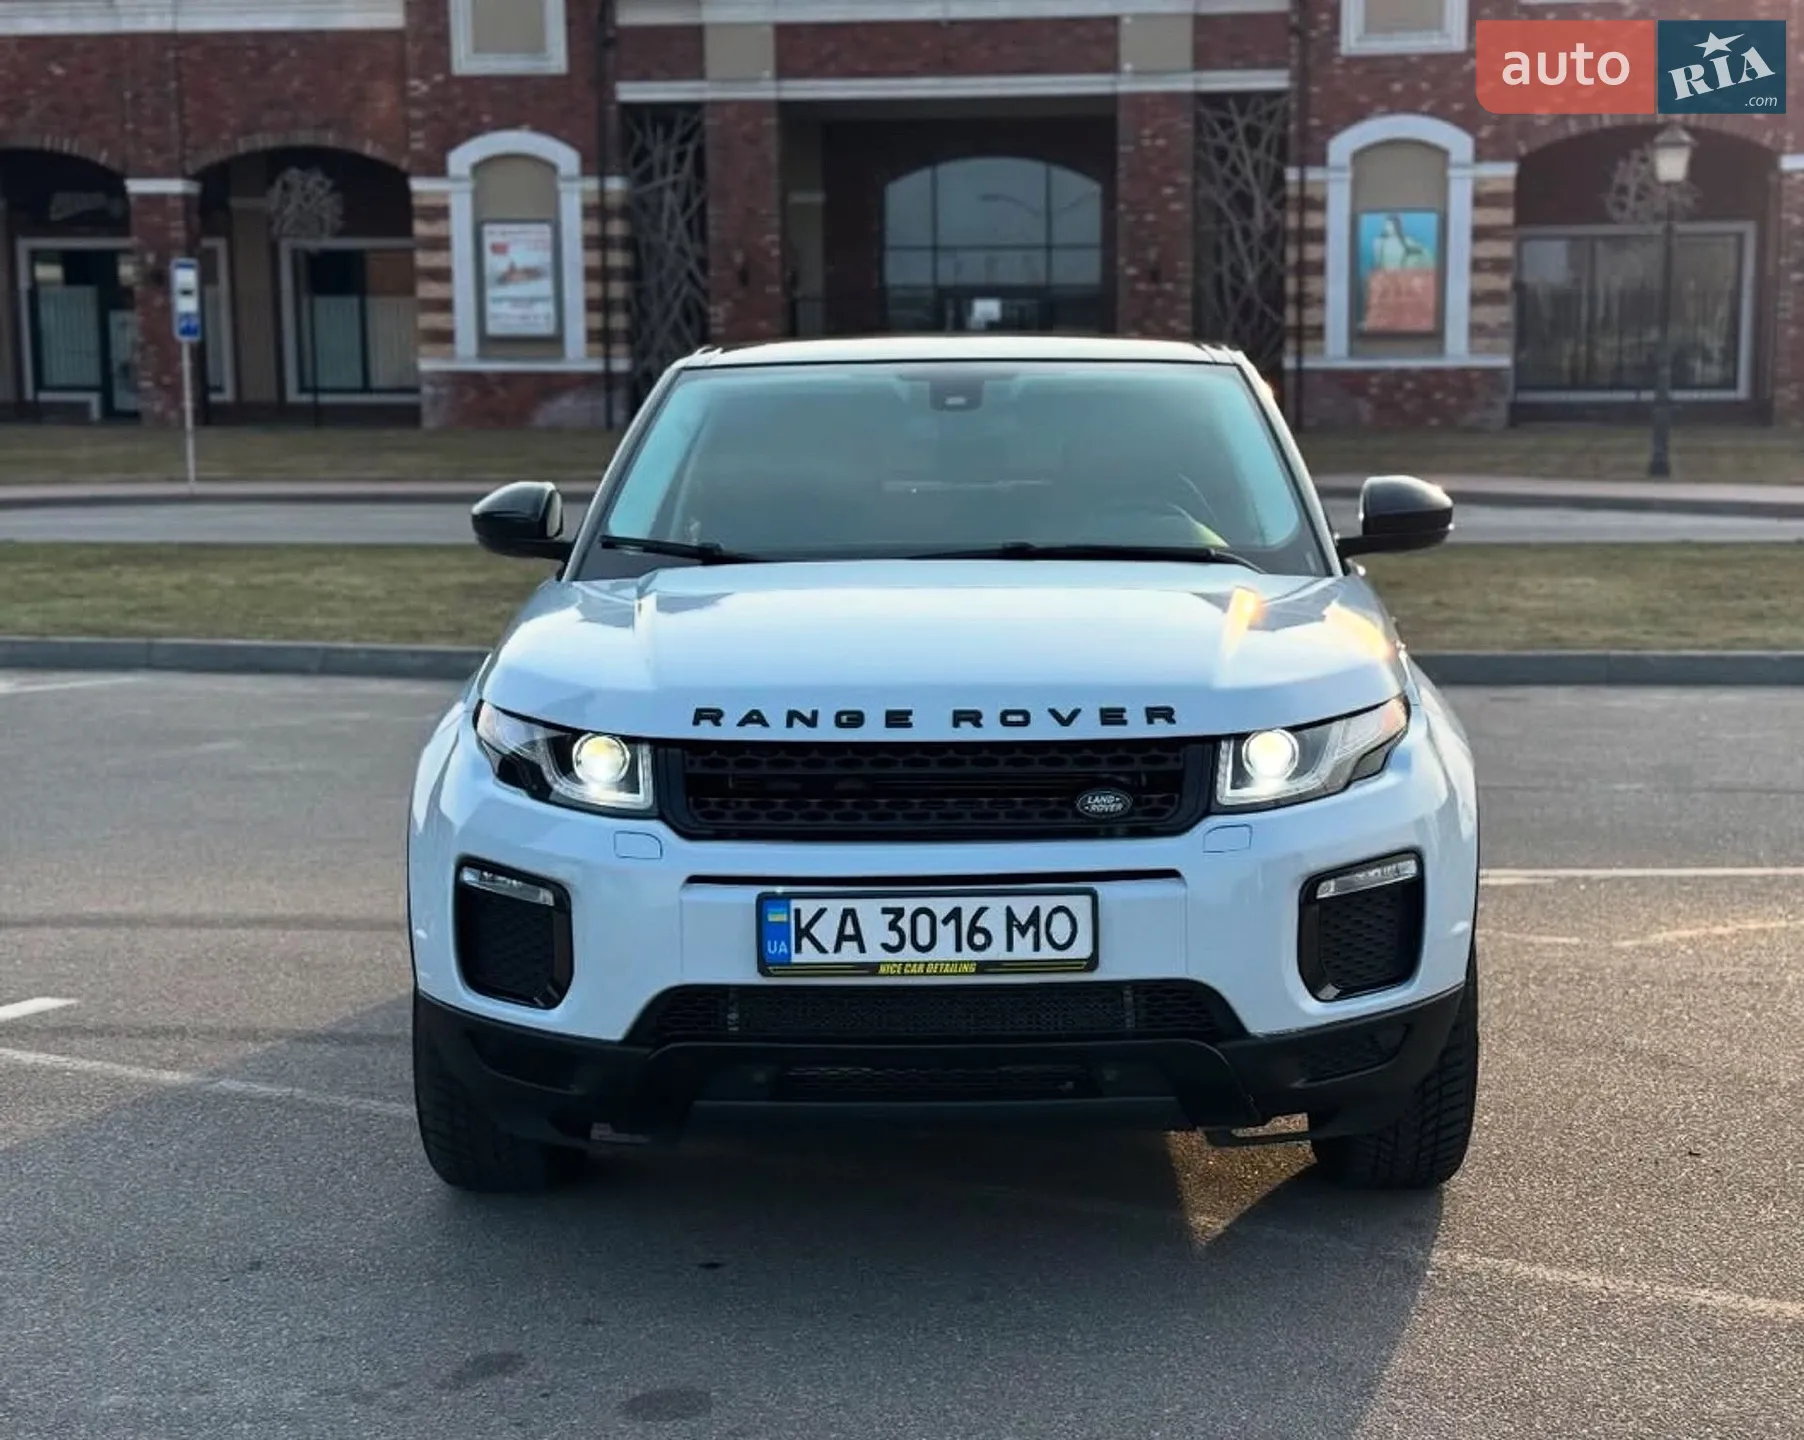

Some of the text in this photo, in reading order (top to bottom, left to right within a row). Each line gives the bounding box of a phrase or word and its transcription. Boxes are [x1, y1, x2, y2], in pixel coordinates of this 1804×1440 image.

[692, 706, 1177, 728] RANGE ROVER
[1087, 795, 1115, 804] LAND
[794, 905, 1079, 955] KA 3016 MO
[767, 940, 788, 954] UA
[878, 963, 977, 975] NICE CAR DETAILING
